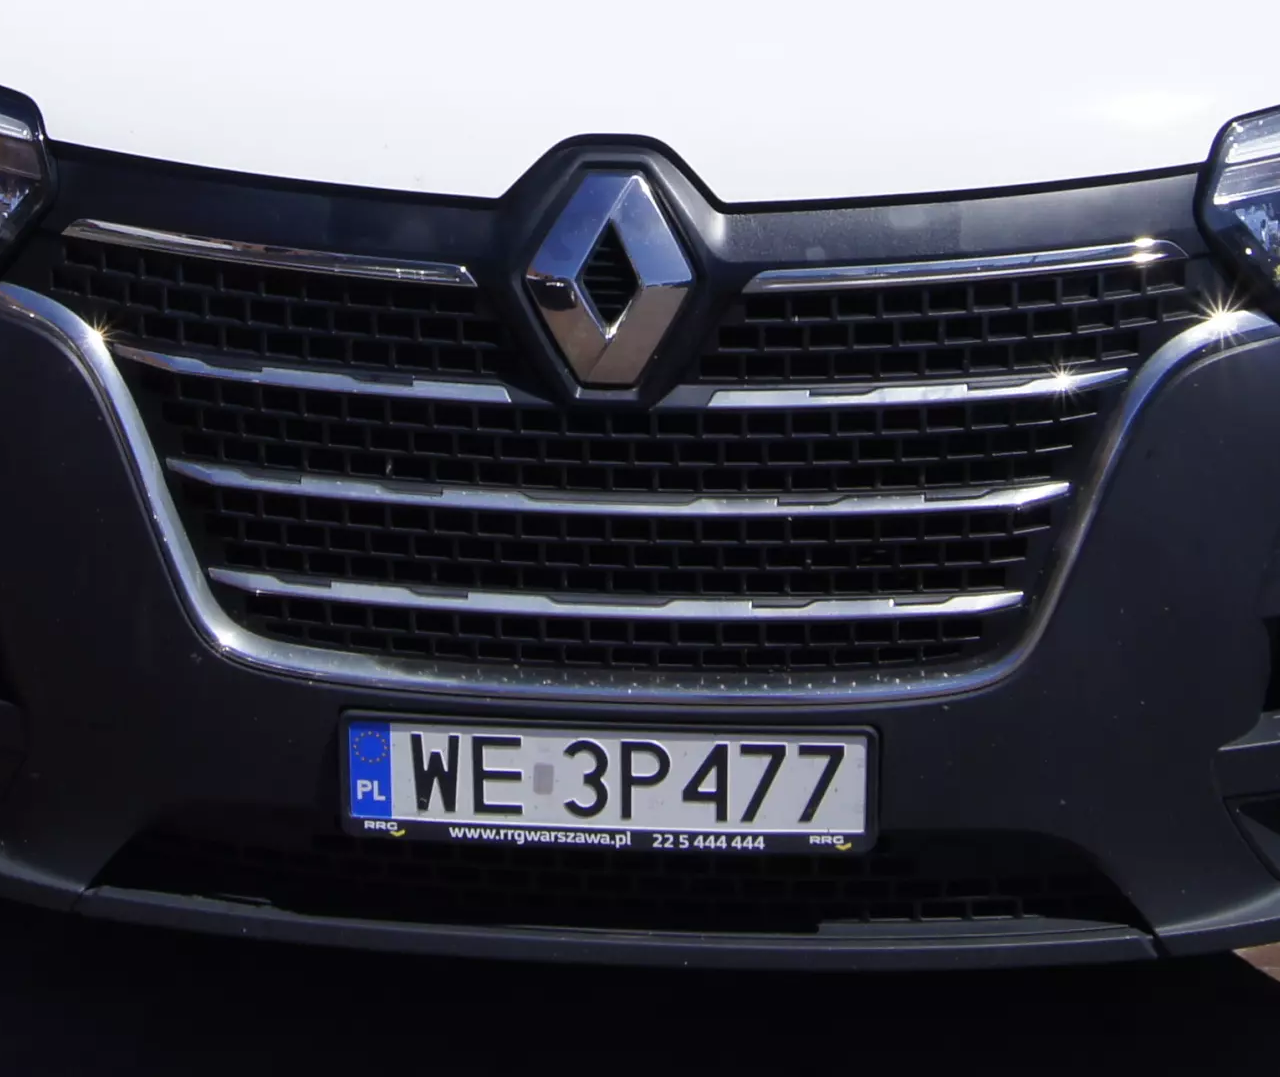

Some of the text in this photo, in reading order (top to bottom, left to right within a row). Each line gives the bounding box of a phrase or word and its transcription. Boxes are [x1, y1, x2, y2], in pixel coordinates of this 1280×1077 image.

[411, 732, 846, 823] WE 3P477
[357, 780, 386, 801] PL
[364, 820, 398, 831] RRG
[449, 826, 632, 846] www.rrgwarszawa.pl
[652, 833, 765, 850] 22 5 444 444
[809, 835, 844, 845] RRG
